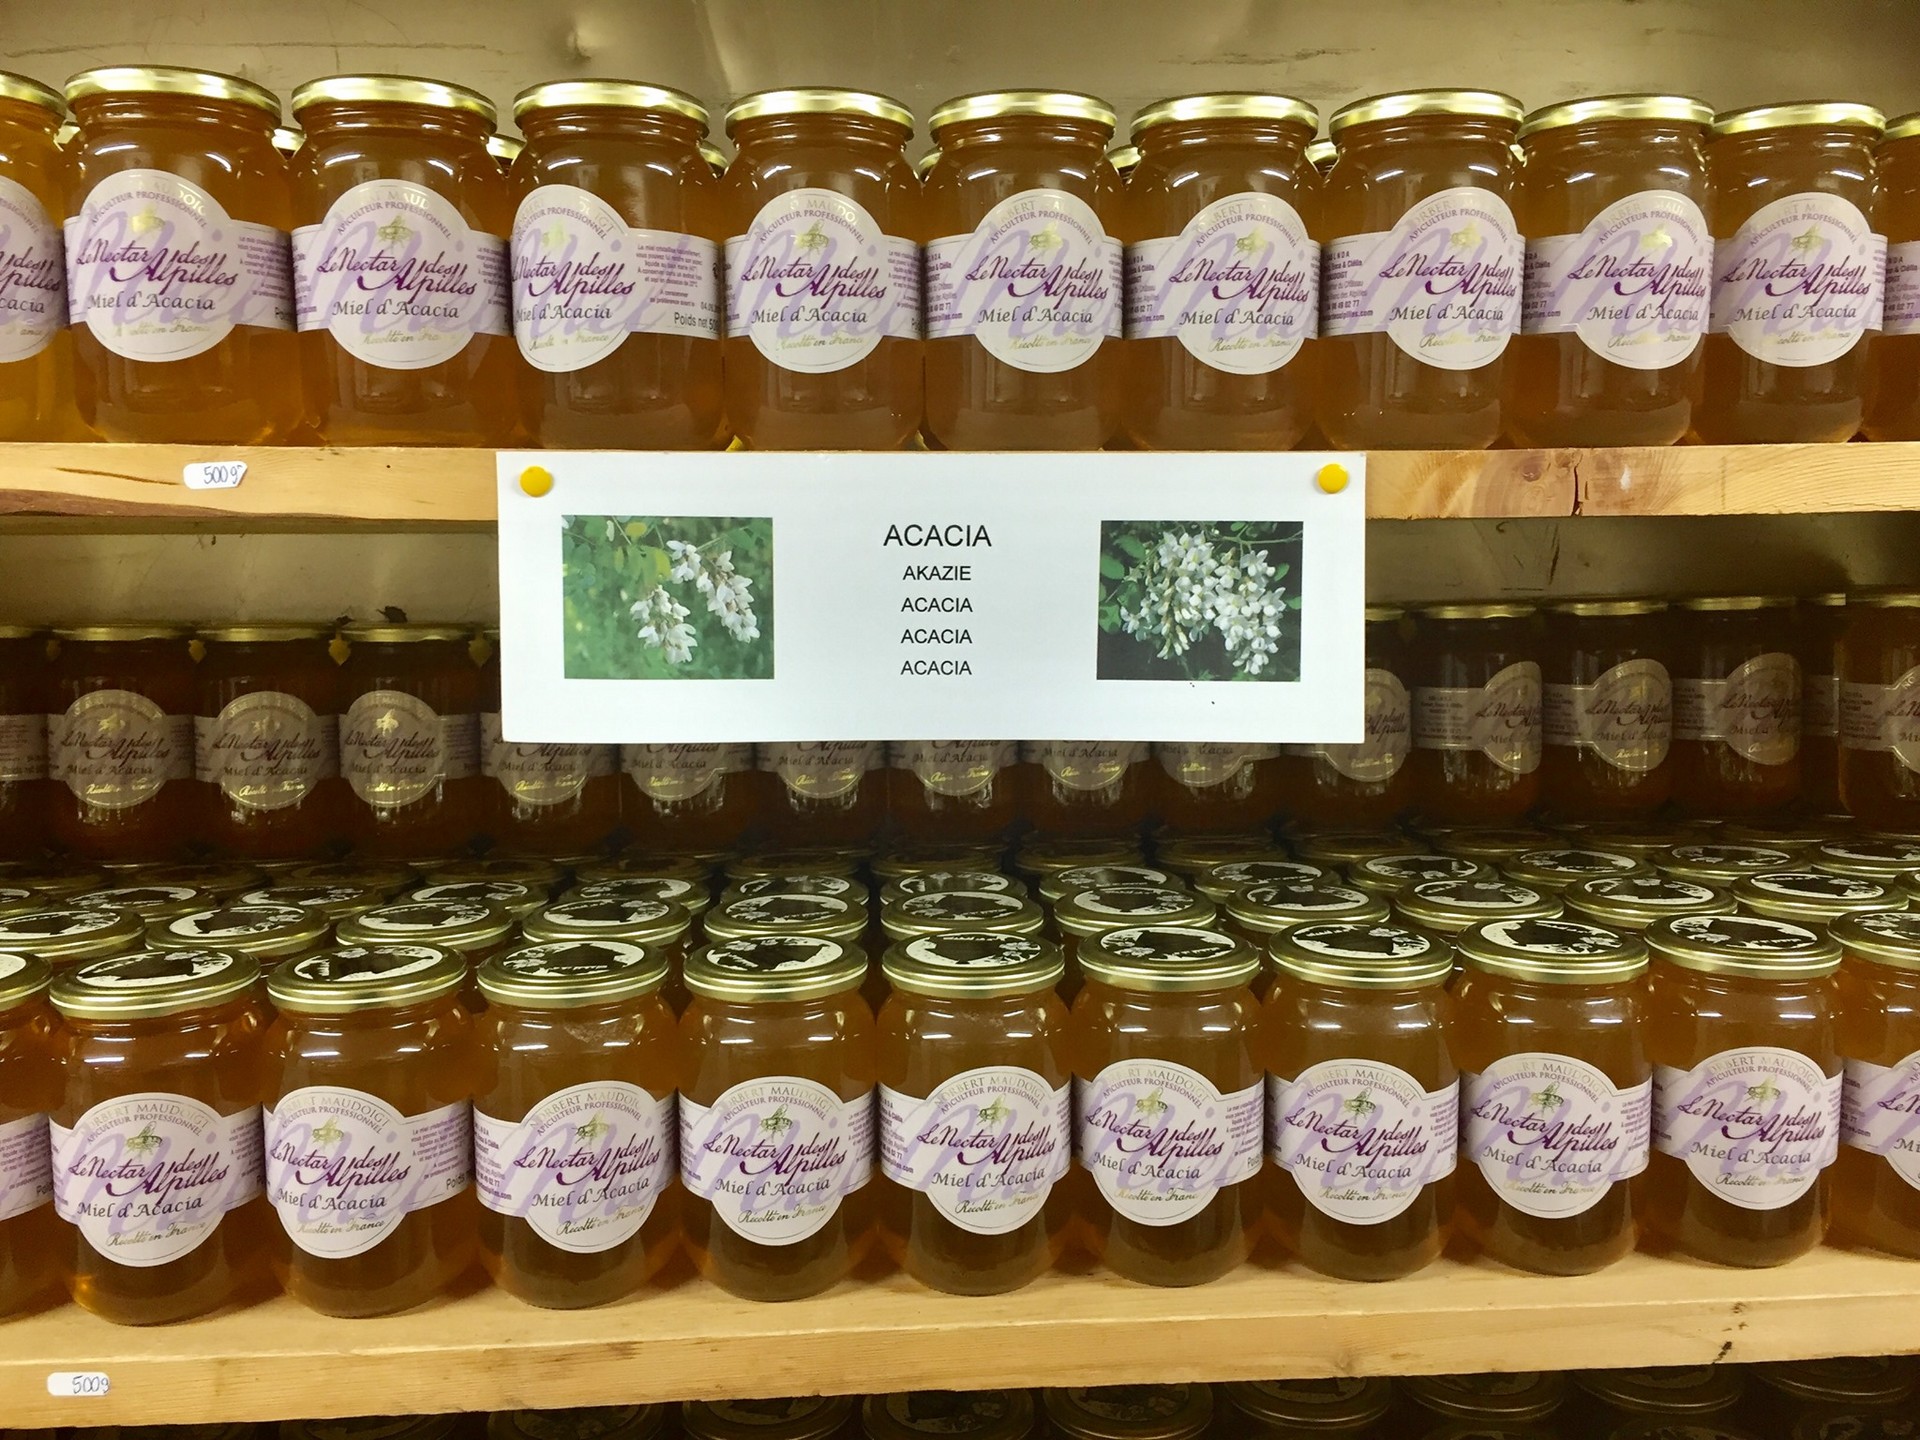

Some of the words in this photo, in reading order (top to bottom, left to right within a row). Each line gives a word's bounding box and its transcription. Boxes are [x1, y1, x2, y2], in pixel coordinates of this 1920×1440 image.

[93, 238, 148, 264] Nectar
[337, 248, 400, 273] Nectar
[110, 248, 239, 295] Alpilles
[759, 256, 815, 279] Nectar
[990, 256, 1051, 279] Nectar
[1194, 258, 1252, 282] Nectar
[1408, 254, 1467, 277] Nectar
[1595, 255, 1655, 279] Nectar
[1747, 258, 1809, 280] Nectar
[357, 258, 477, 304] Alpilles
[528, 261, 635, 308] Alpilles
[776, 264, 887, 309] Alpilles
[1008, 265, 1108, 310] Alpilles
[1212, 267, 1309, 312] Alpilles
[1425, 262, 1517, 308] Alpilles
[1765, 263, 1872, 307] Alpilles
[88, 293, 121, 310] Miel
[127, 292, 216, 310] d'Acacia
[332, 301, 369, 316] Miel
[377, 300, 459, 318] d'Acacia
[539, 304, 612, 319] d'Acacia
[1389, 303, 1430, 321] Miel
[1437, 303, 1504, 321] d'Acacia
[1587, 304, 1630, 321] Miel
[1635, 303, 1698, 321] d'Acacia
[1734, 306, 1778, 322] Miel
[1783, 303, 1857, 319] d'Acacia
[751, 306, 785, 324] Miel
[791, 305, 867, 323] d'Acacia
[978, 305, 1017, 324] Miel
[1023, 305, 1093, 323] d'Acacia
[1179, 308, 1219, 326] Miel
[1224, 308, 1294, 326] d'Acacia
[204, 466, 228, 485] 500
[883, 524, 992, 546] ACACIA
[903, 566, 971, 580] AKAZIE
[901, 598, 973, 612] ACACIA
[901, 629, 972, 643] ACACIA
[901, 661, 972, 675] ACACIA
[1492, 1103, 1550, 1133] Nectar
[1705, 1098, 1763, 1126] Nectar
[940, 1125, 998, 1148] Nectar
[1102, 1111, 1153, 1139] Nectar
[1304, 1111, 1362, 1139] Nectar
[1721, 1111, 1826, 1153] Alpilles
[723, 1134, 779, 1158] Nectar
[957, 1125, 1056, 1175] Alpilles
[1117, 1127, 1224, 1168] Alpilles
[1321, 1126, 1429, 1168] Alpilles
[1508, 1122, 1618, 1162] Alpilles
[1690, 1142, 1736, 1161] Miel
[1737, 1150, 1811, 1164] d'Acacia
[280, 1142, 331, 1169] Nectar
[538, 1147, 597, 1169] Nectar
[556, 1136, 661, 1192] Alpilles
[739, 1136, 847, 1186] Alpilles
[1094, 1152, 1124, 1172] Miel
[1128, 1164, 1202, 1179] d'Acacia
[1296, 1154, 1333, 1173] Miel
[1337, 1164, 1412, 1179] d'Acacia
[1483, 1146, 1522, 1166] Miel
[1526, 1158, 1602, 1174] d'Acacia
[87, 1156, 146, 1180] Nectar
[106, 1152, 229, 1206] Alpilles
[296, 1152, 411, 1199] Alpilles
[932, 1172, 975, 1188] Miel
[976, 1167, 1046, 1187] d'Acacia
[532, 1191, 575, 1208] Miel
[578, 1176, 650, 1203] d'Acacia
[715, 1179, 754, 1195] Miel
[757, 1178, 830, 1196] d'Acacia
[77, 1202, 112, 1218] Miel
[118, 1196, 204, 1218] d'Acacia
[278, 1190, 304, 1206] Miel
[309, 1195, 387, 1210] d'Acacia
[72, 1375, 109, 1394] 500g
